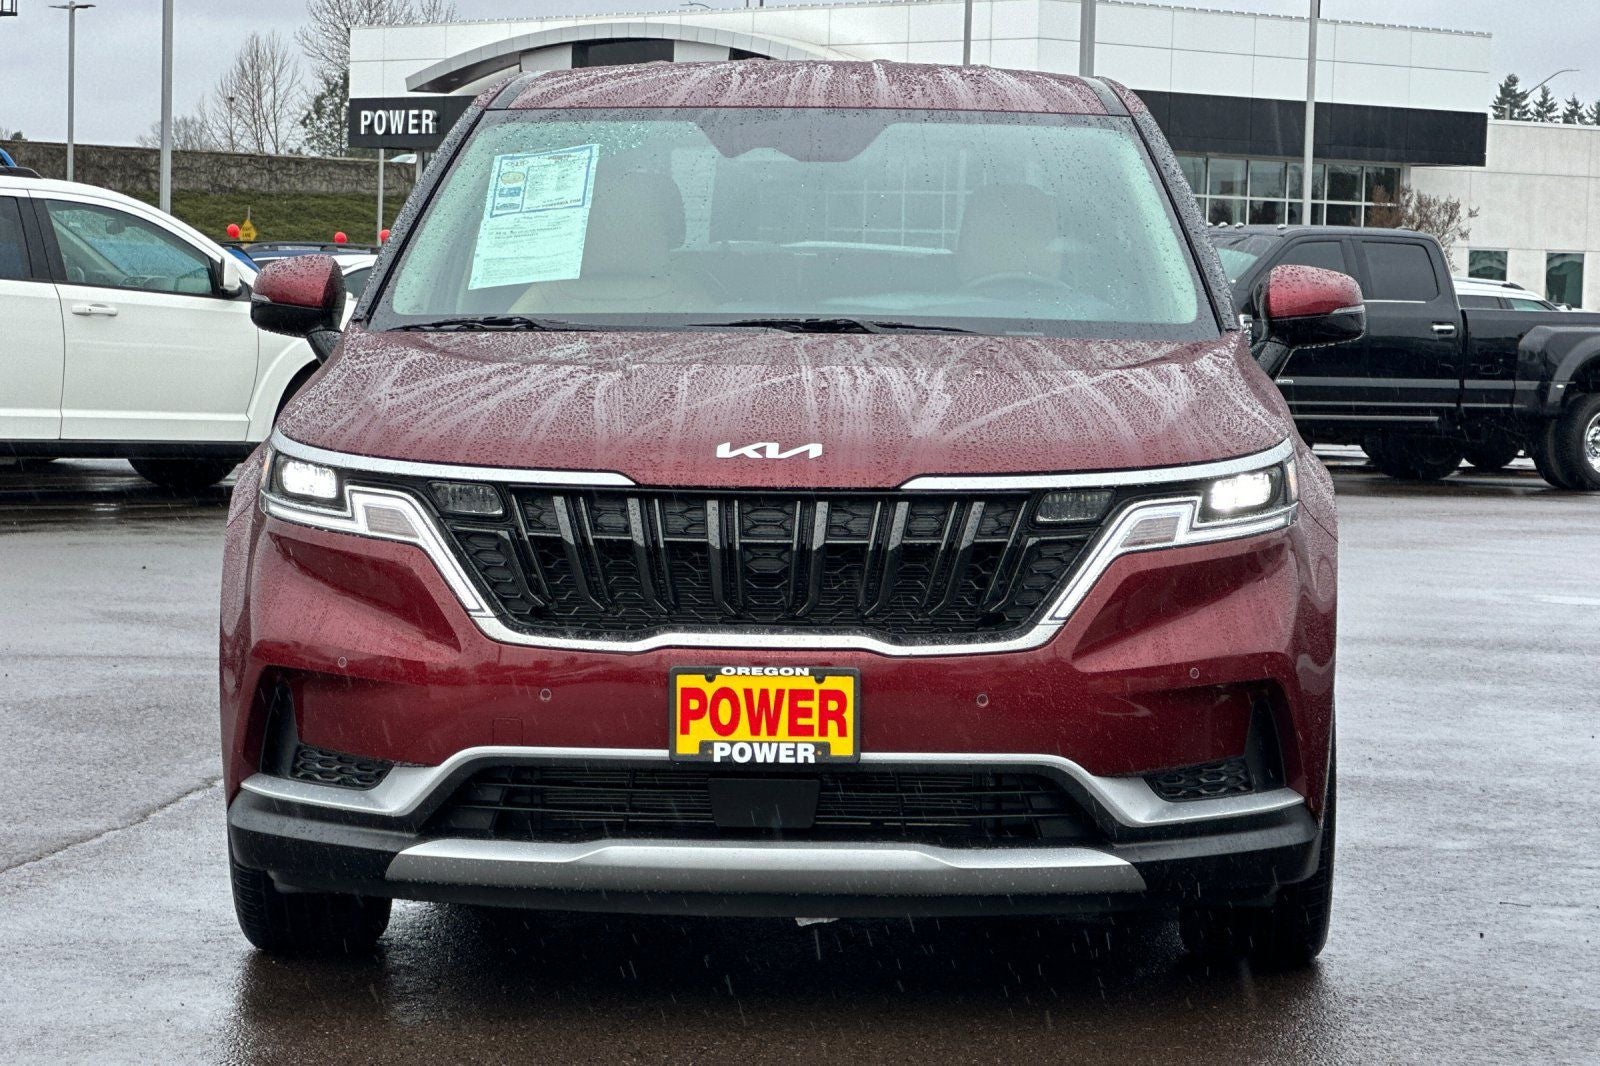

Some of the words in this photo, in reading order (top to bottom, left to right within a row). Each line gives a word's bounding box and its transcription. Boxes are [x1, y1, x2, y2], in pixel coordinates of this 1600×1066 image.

[360, 109, 436, 135] POWER
[716, 442, 822, 459] KIA
[720, 666, 810, 676] OREGON
[680, 687, 848, 737] POWER
[713, 742, 815, 763] POWER
